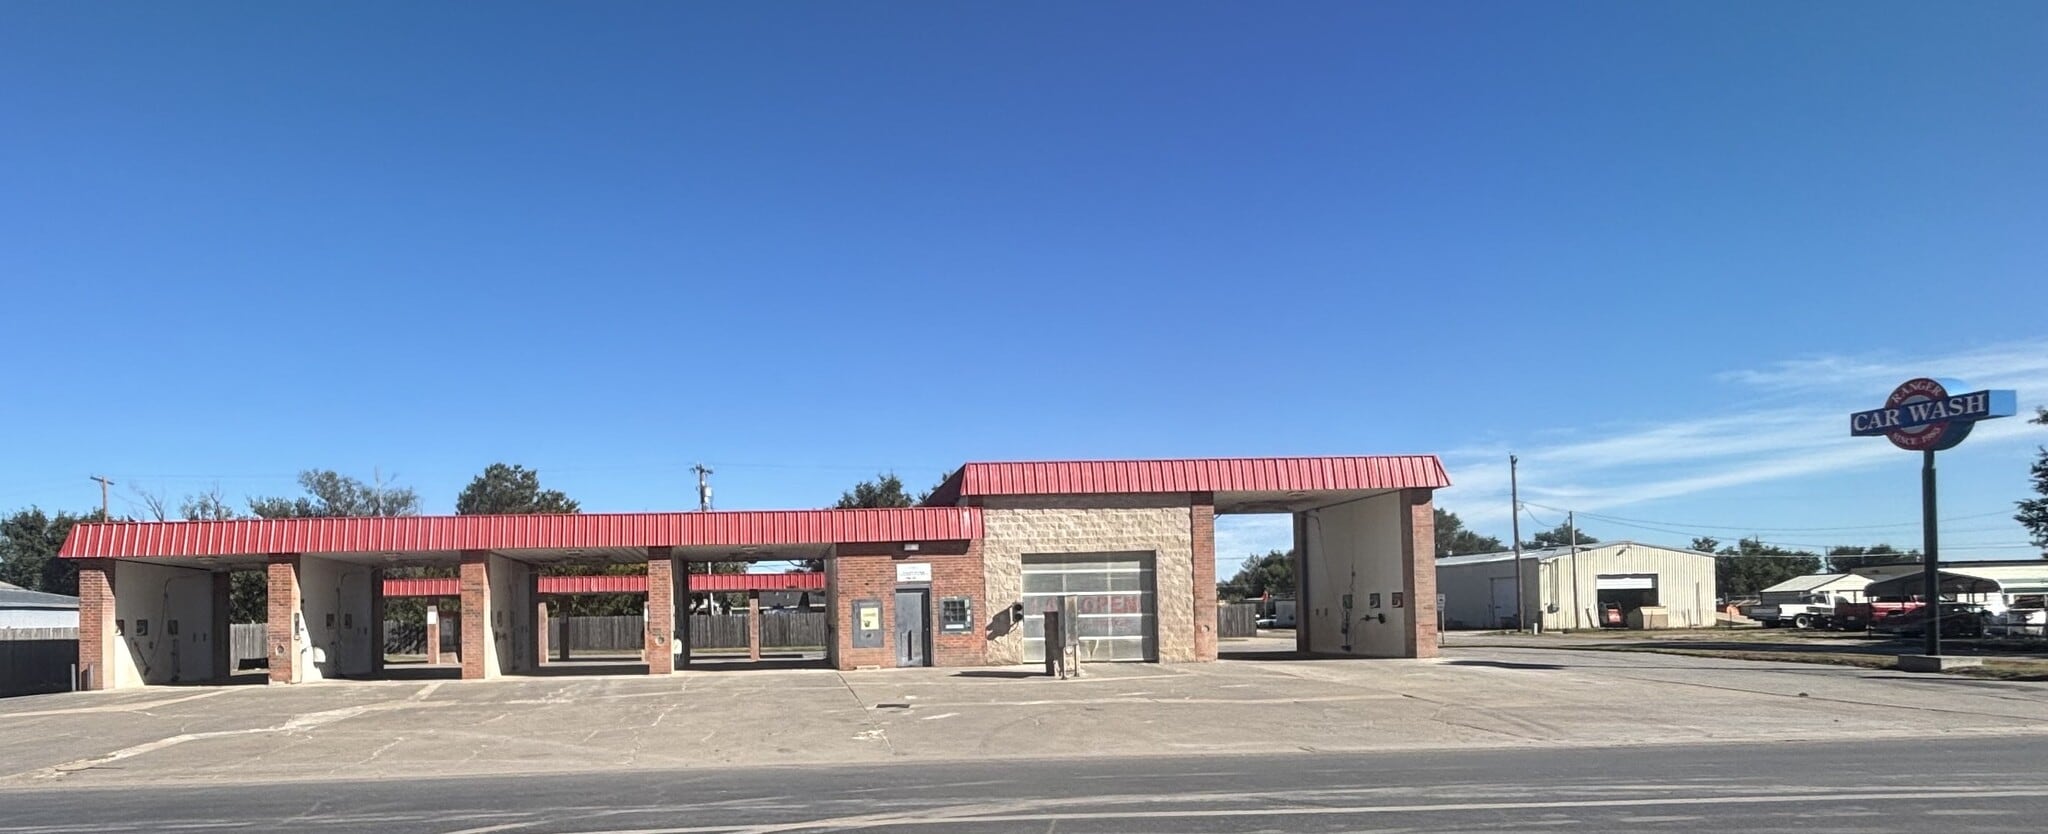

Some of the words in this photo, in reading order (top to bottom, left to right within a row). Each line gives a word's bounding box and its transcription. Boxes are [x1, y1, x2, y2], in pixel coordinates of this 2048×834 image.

[1891, 380, 1942, 403] RANGER
[1853, 408, 1900, 431] CAR
[1907, 393, 1987, 422] WASH
[1893, 432, 1915, 445] SINCE
[1081, 595, 1138, 614] OPEN
